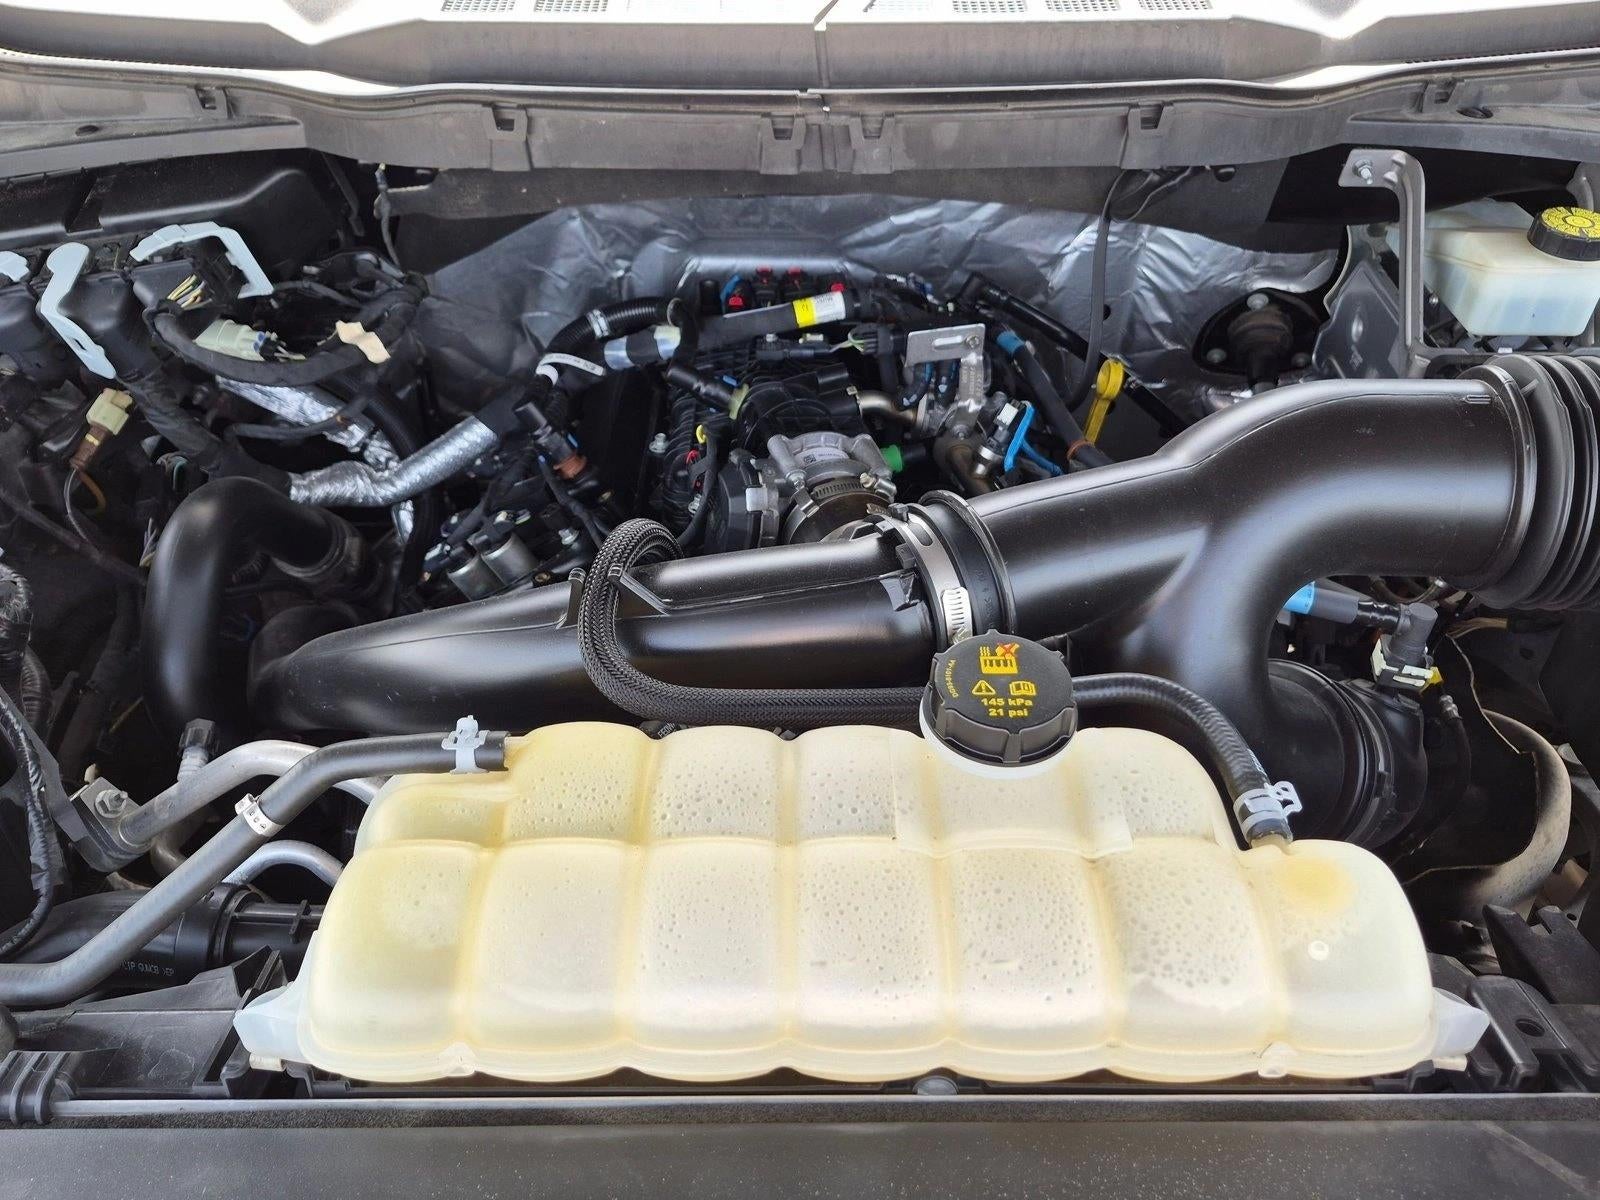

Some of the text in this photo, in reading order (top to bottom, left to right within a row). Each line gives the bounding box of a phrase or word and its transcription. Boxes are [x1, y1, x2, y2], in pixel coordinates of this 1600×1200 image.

[981, 698, 1033, 706] 145 kPa
[988, 708, 1029, 718] 21 psi
